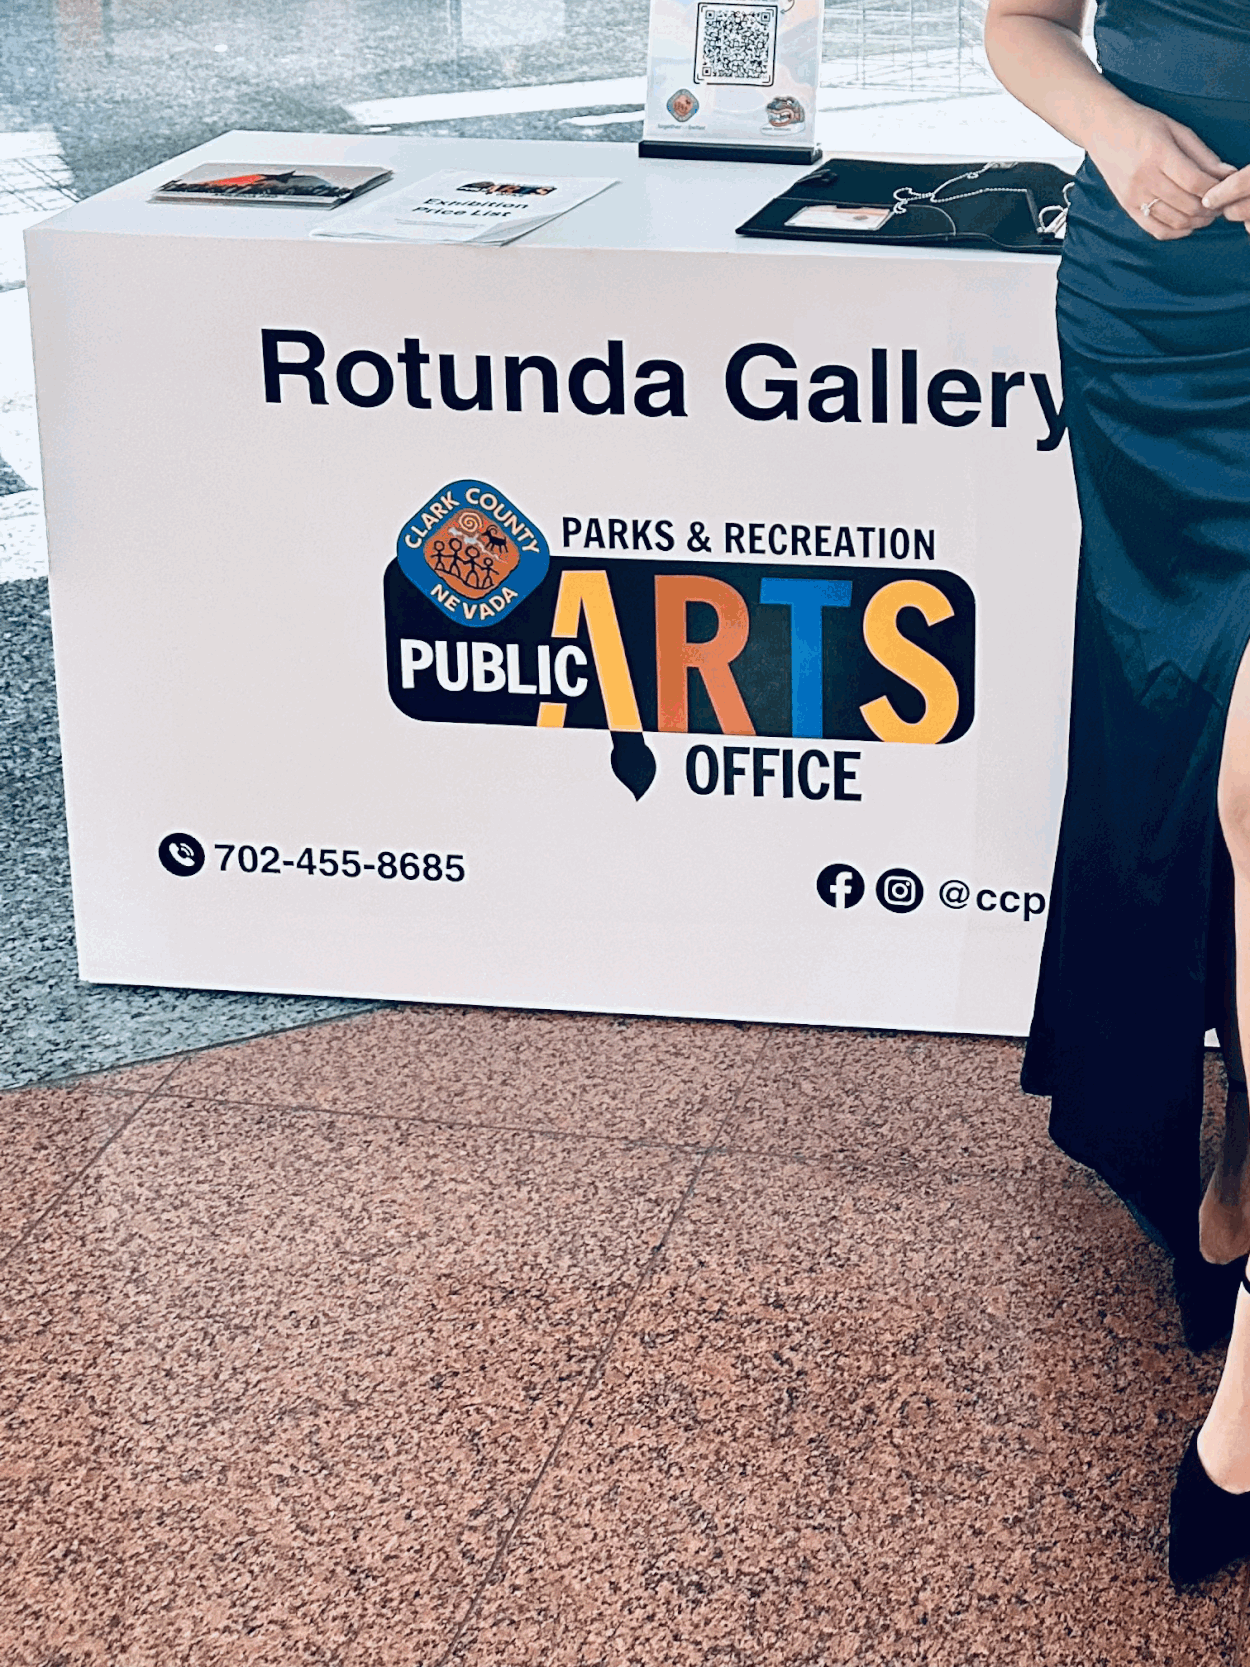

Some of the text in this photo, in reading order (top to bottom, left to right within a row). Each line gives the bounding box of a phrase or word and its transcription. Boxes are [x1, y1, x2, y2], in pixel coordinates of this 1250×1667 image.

[412, 206, 512, 217] Price List
[423, 198, 529, 209] Exhibition
[260, 327, 1066, 452] Rotunda Gallery
[405, 487, 540, 554] CLARK COUNTY
[562, 516, 936, 561] PARKS & RECREATION
[430, 584, 518, 620] NEVADA
[400, 569, 960, 745] PUBLIC ARTS
[685, 743, 863, 803] OFFICE
[213, 842, 466, 883] 702-455-8685
